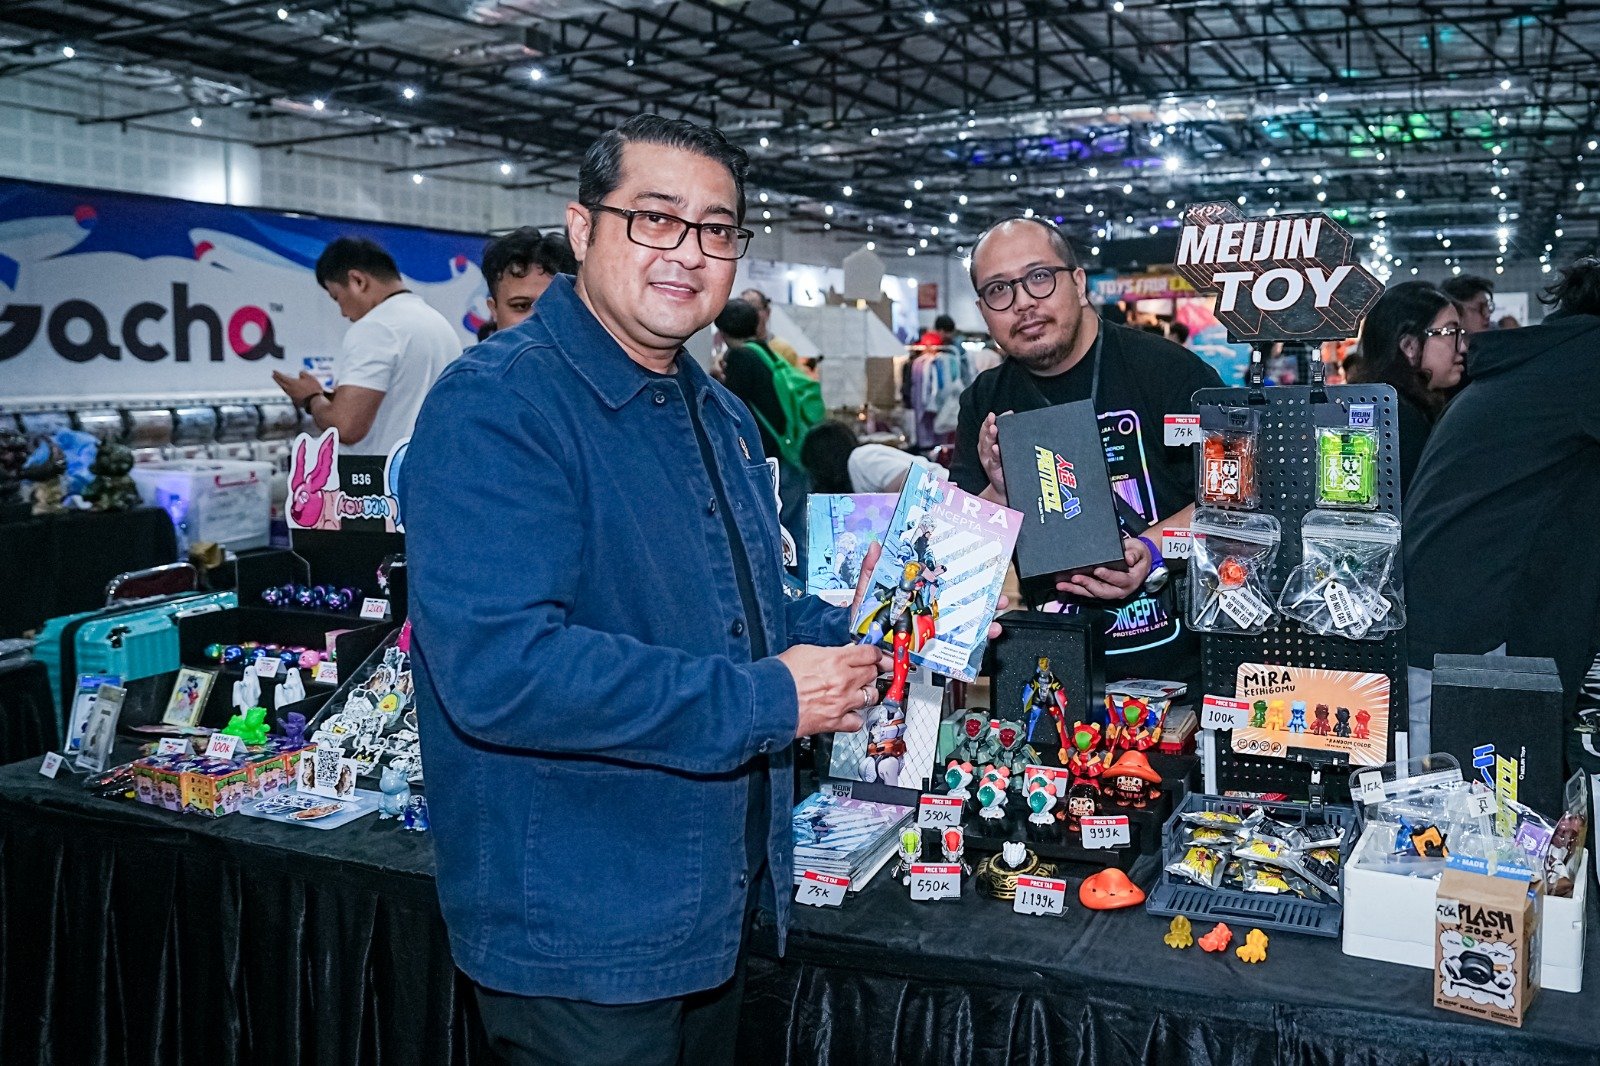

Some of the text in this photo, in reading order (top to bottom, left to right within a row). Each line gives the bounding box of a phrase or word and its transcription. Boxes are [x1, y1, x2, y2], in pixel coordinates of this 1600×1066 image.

[1177, 217, 1323, 266] MEIJIN
[1212, 265, 1355, 312] TOY
[351, 473, 372, 486] B36
[917, 472, 1009, 529] MIRA
[1225, 600, 1234, 610] DO
[1231, 606, 1242, 616] NOT
[1112, 620, 1169, 638] PROTECTIVE LAYER
[1244, 671, 1292, 688] MiRA
[833, 790, 850, 798] TOY
[1461, 858, 1485, 868] MADE
[1029, 880, 1043, 888] PRICE
[1464, 925, 1493, 938] 206
